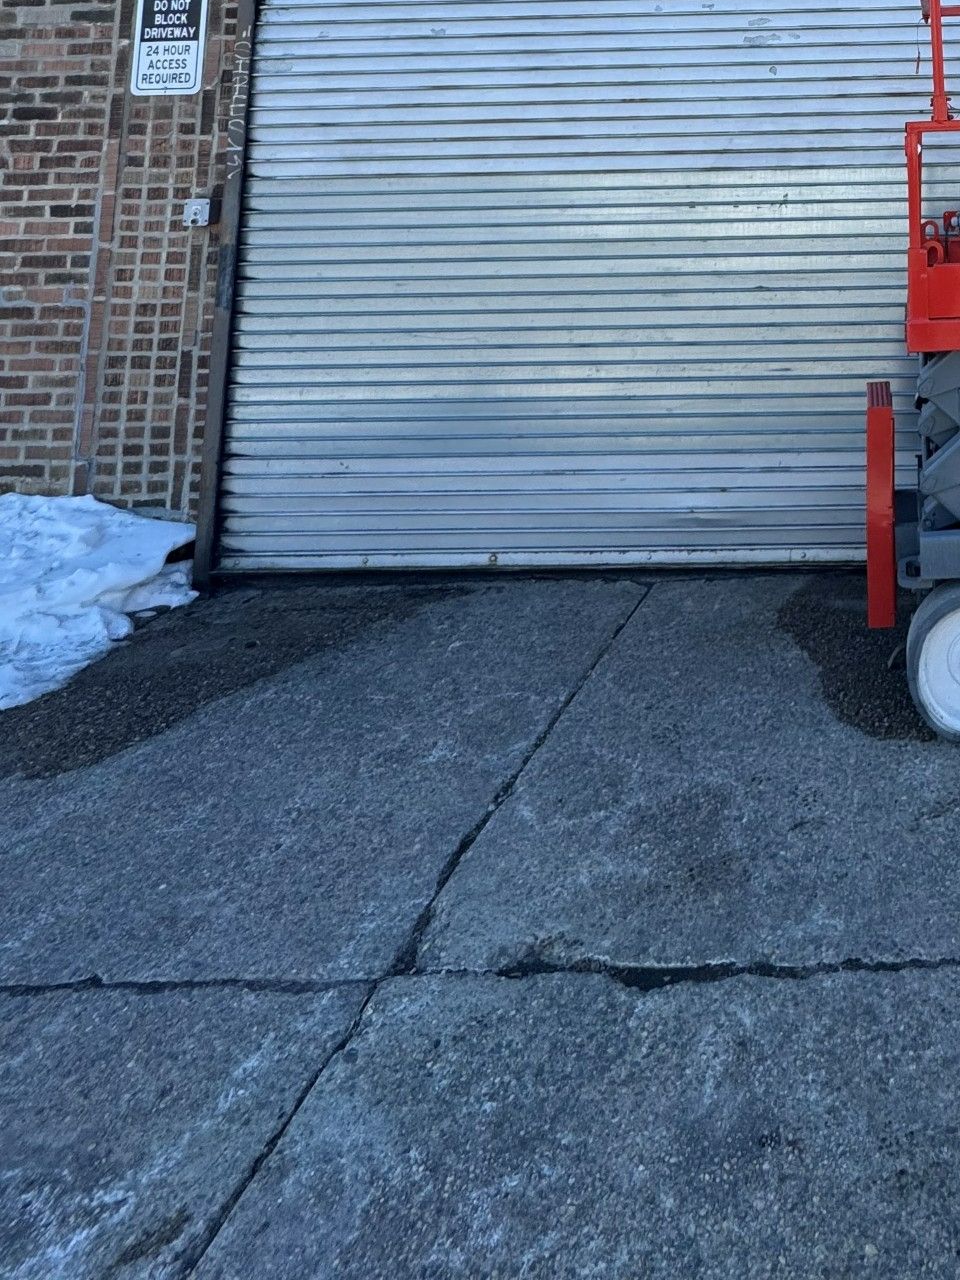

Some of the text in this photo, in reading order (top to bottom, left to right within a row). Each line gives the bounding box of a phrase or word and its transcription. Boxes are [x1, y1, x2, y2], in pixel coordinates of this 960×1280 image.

[154, 0, 191, 11] DO NOT
[154, 13, 188, 25] BLOCK
[144, 27, 196, 39] DRIVEWAY
[146, 45, 191, 56] 24 HOUR
[147, 59, 187, 70] ACCESS
[141, 73, 191, 84] REQUIRED
